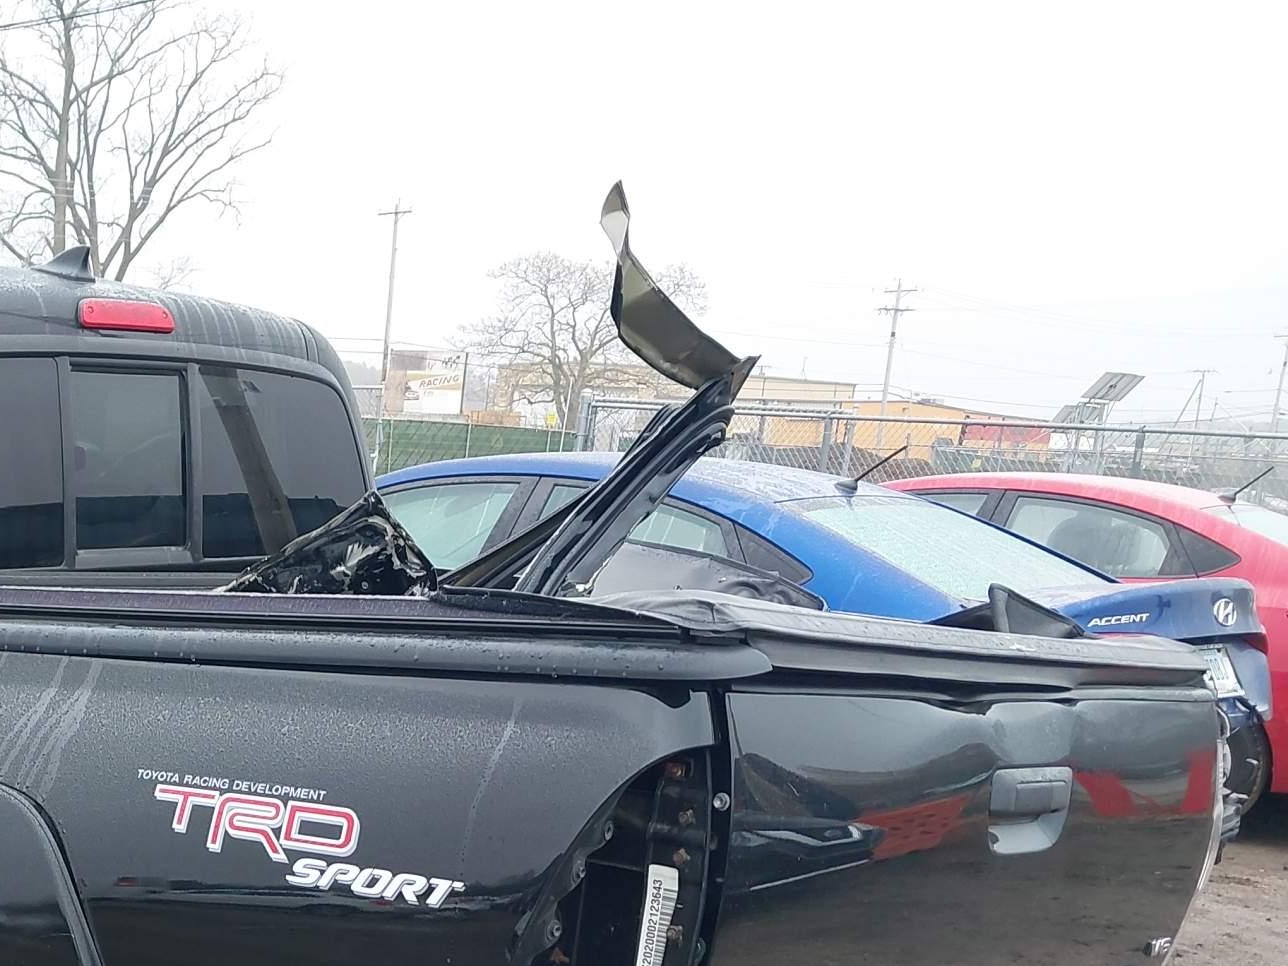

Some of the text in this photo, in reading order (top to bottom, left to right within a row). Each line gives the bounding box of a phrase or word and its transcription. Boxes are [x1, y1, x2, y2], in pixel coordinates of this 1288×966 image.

[419, 375, 460, 388] RACING
[1087, 613, 1150, 627] ACCENT
[137, 769, 327, 801] TOYOTA RACING DEVELOPMENT
[154, 783, 361, 864] TRD
[285, 858, 466, 908] SPORT
